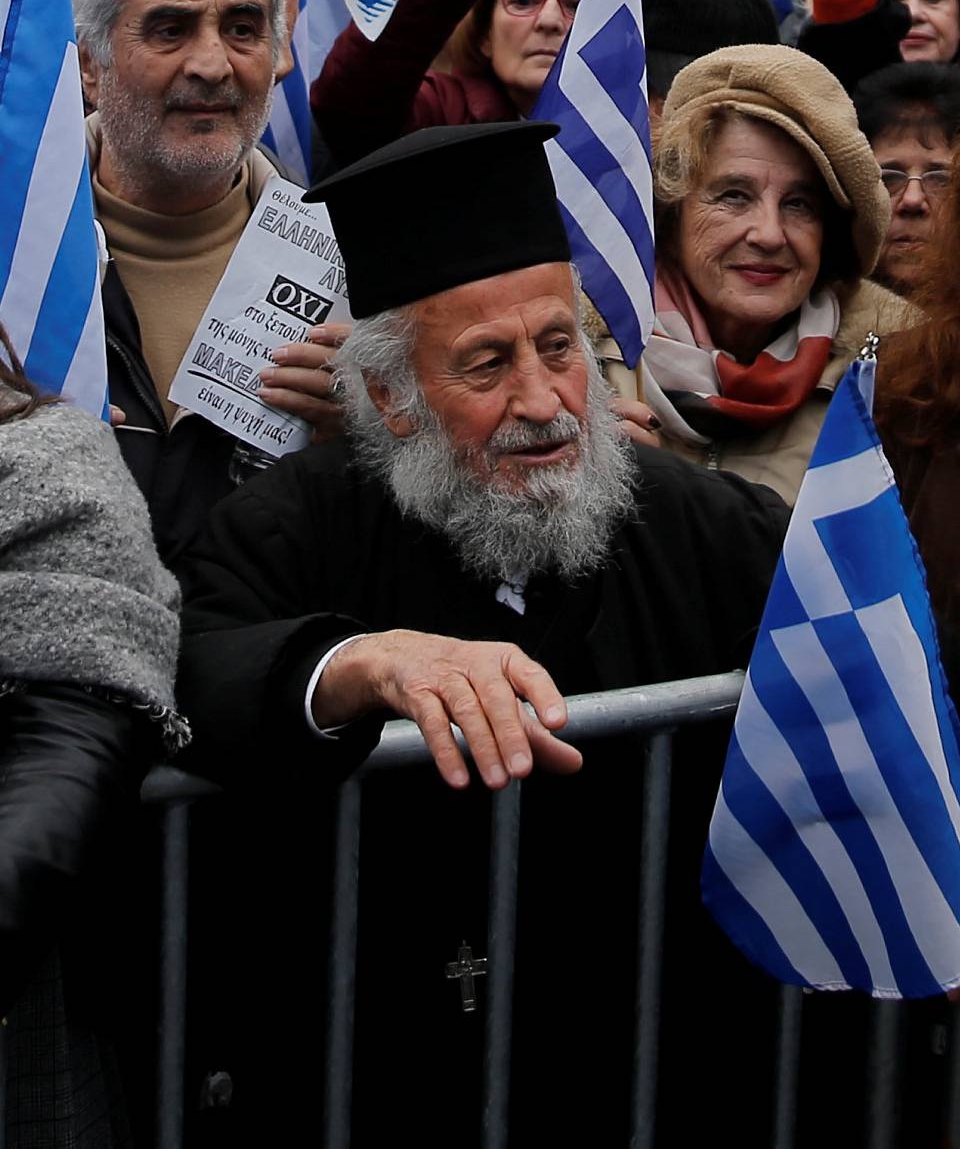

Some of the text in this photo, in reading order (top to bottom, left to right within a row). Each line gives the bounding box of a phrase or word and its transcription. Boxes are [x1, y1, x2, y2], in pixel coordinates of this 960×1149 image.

[244, 306, 266, 324] στο
[271, 281, 330, 323] ΟΧΙ
[207, 318, 229, 339] της
[197, 386, 223, 410] είναι
[223, 401, 234, 421] η
